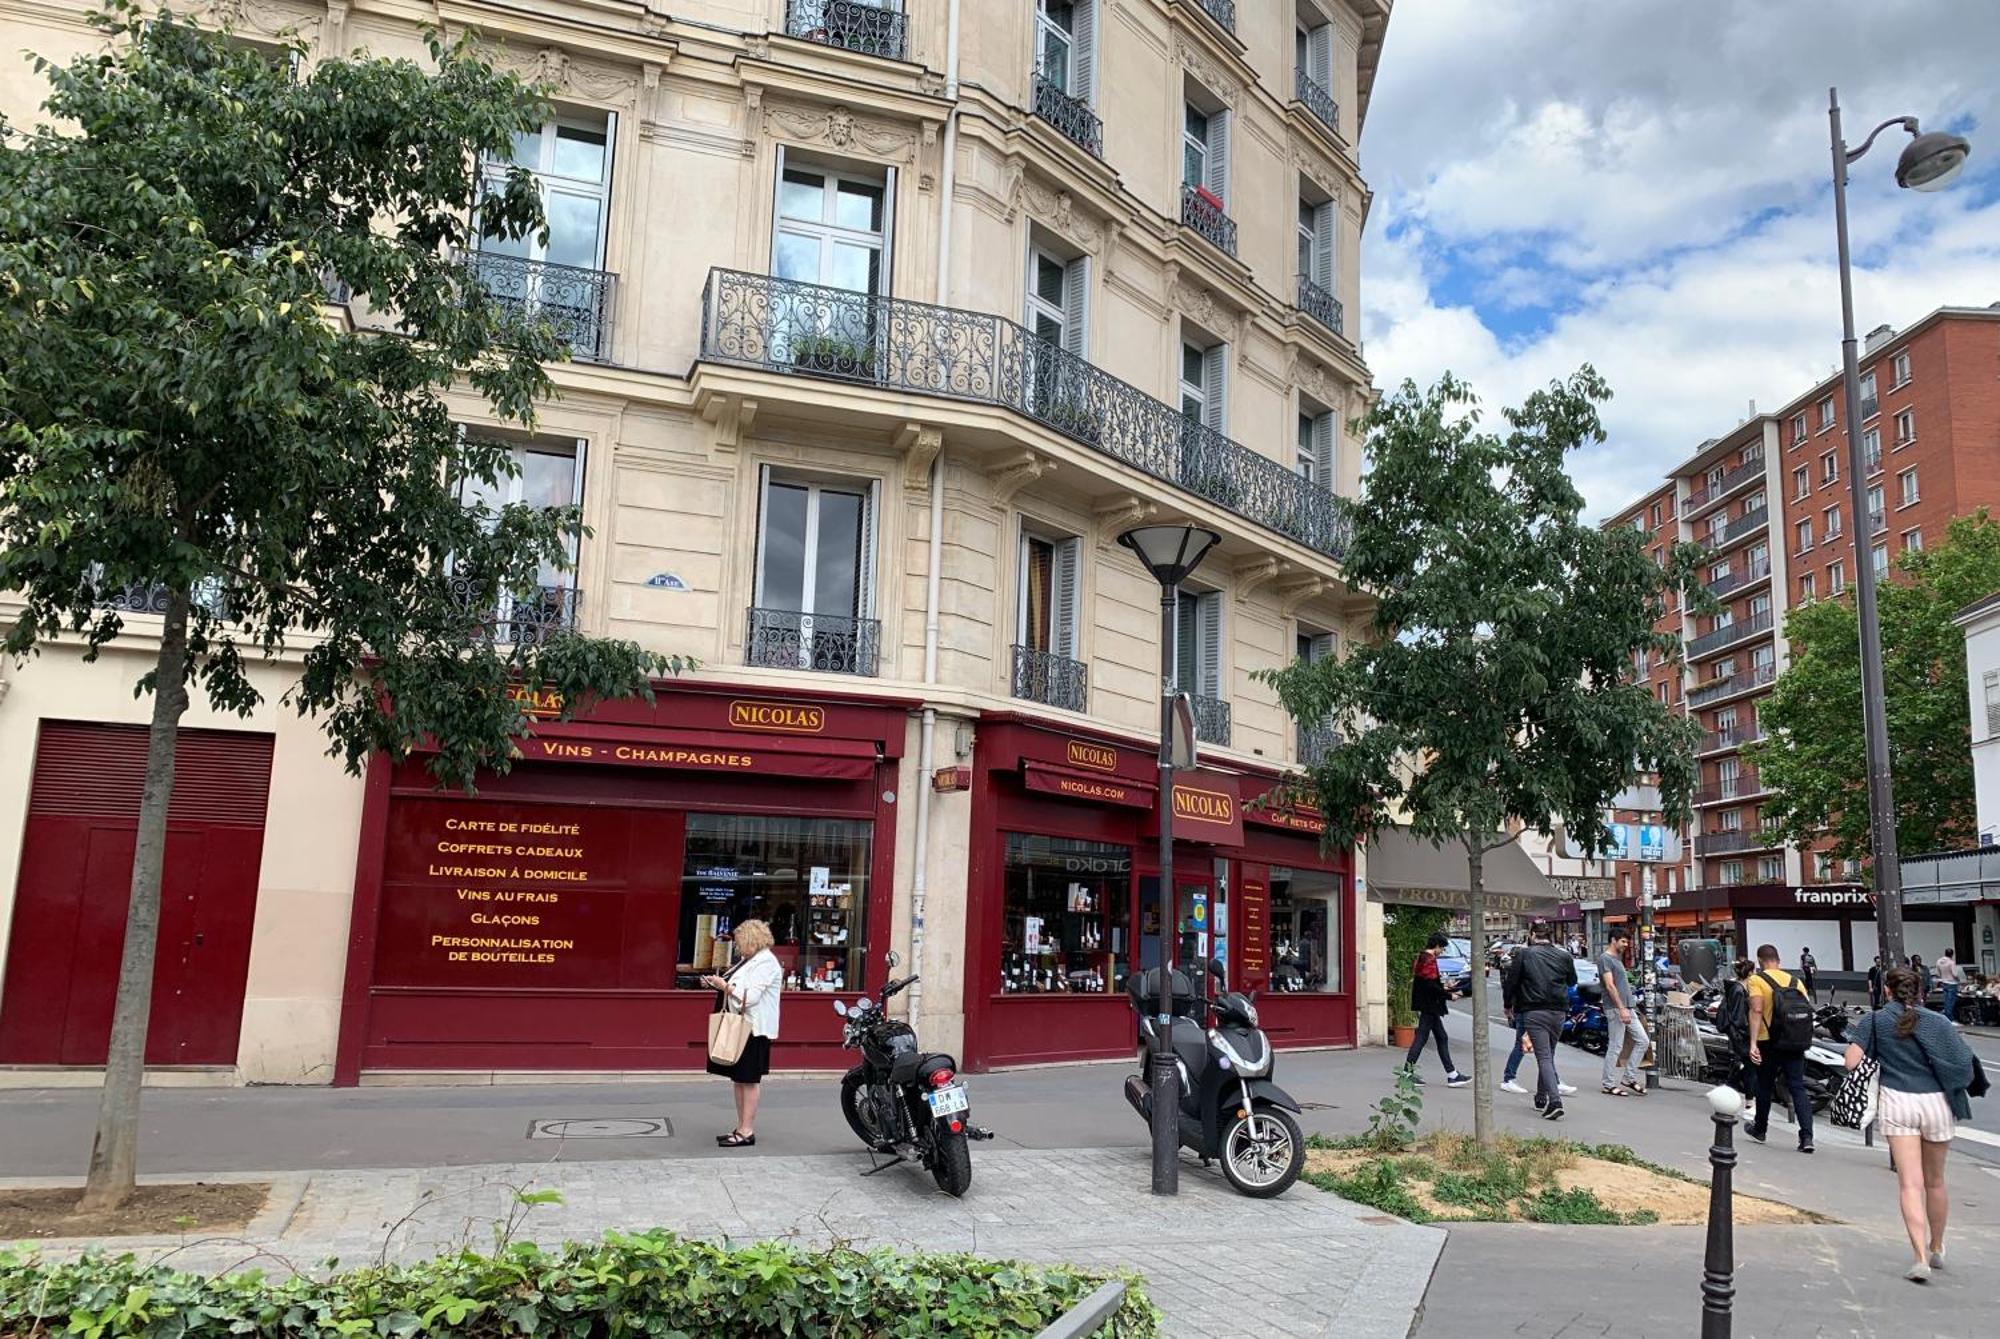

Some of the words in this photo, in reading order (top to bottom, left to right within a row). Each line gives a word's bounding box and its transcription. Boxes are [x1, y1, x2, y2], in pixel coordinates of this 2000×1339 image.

[735, 705, 819, 727] NICOLAS
[543, 742, 592, 758] VINS
[616, 747, 752, 767] CHAMPAGNES
[1071, 744, 1114, 767] NICOLAS
[1060, 780, 1124, 800] NICOLAS.COM
[1175, 791, 1230, 819] NICOLAS
[446, 819, 495, 832] CARTE
[499, 823, 518, 832] DE
[521, 823, 580, 835] FIDÉLITÉ
[438, 842, 512, 855] COFFRETS
[516, 846, 583, 858] CADEAUX
[429, 864, 506, 877] LIVRAISON
[524, 870, 588, 881] DOMICILE
[457, 889, 490, 901] VINS
[495, 892, 514, 901] AU
[517, 893, 558, 902] FRAIS
[1398, 888, 1532, 911] FROMAERIE
[1794, 888, 1868, 905] franprix
[471, 913, 540, 927] GLAÇONS
[432, 935, 573, 949] PERSONNALISATION
[449, 952, 467, 961] DE
[471, 952, 555, 963] BOUTEILLES
